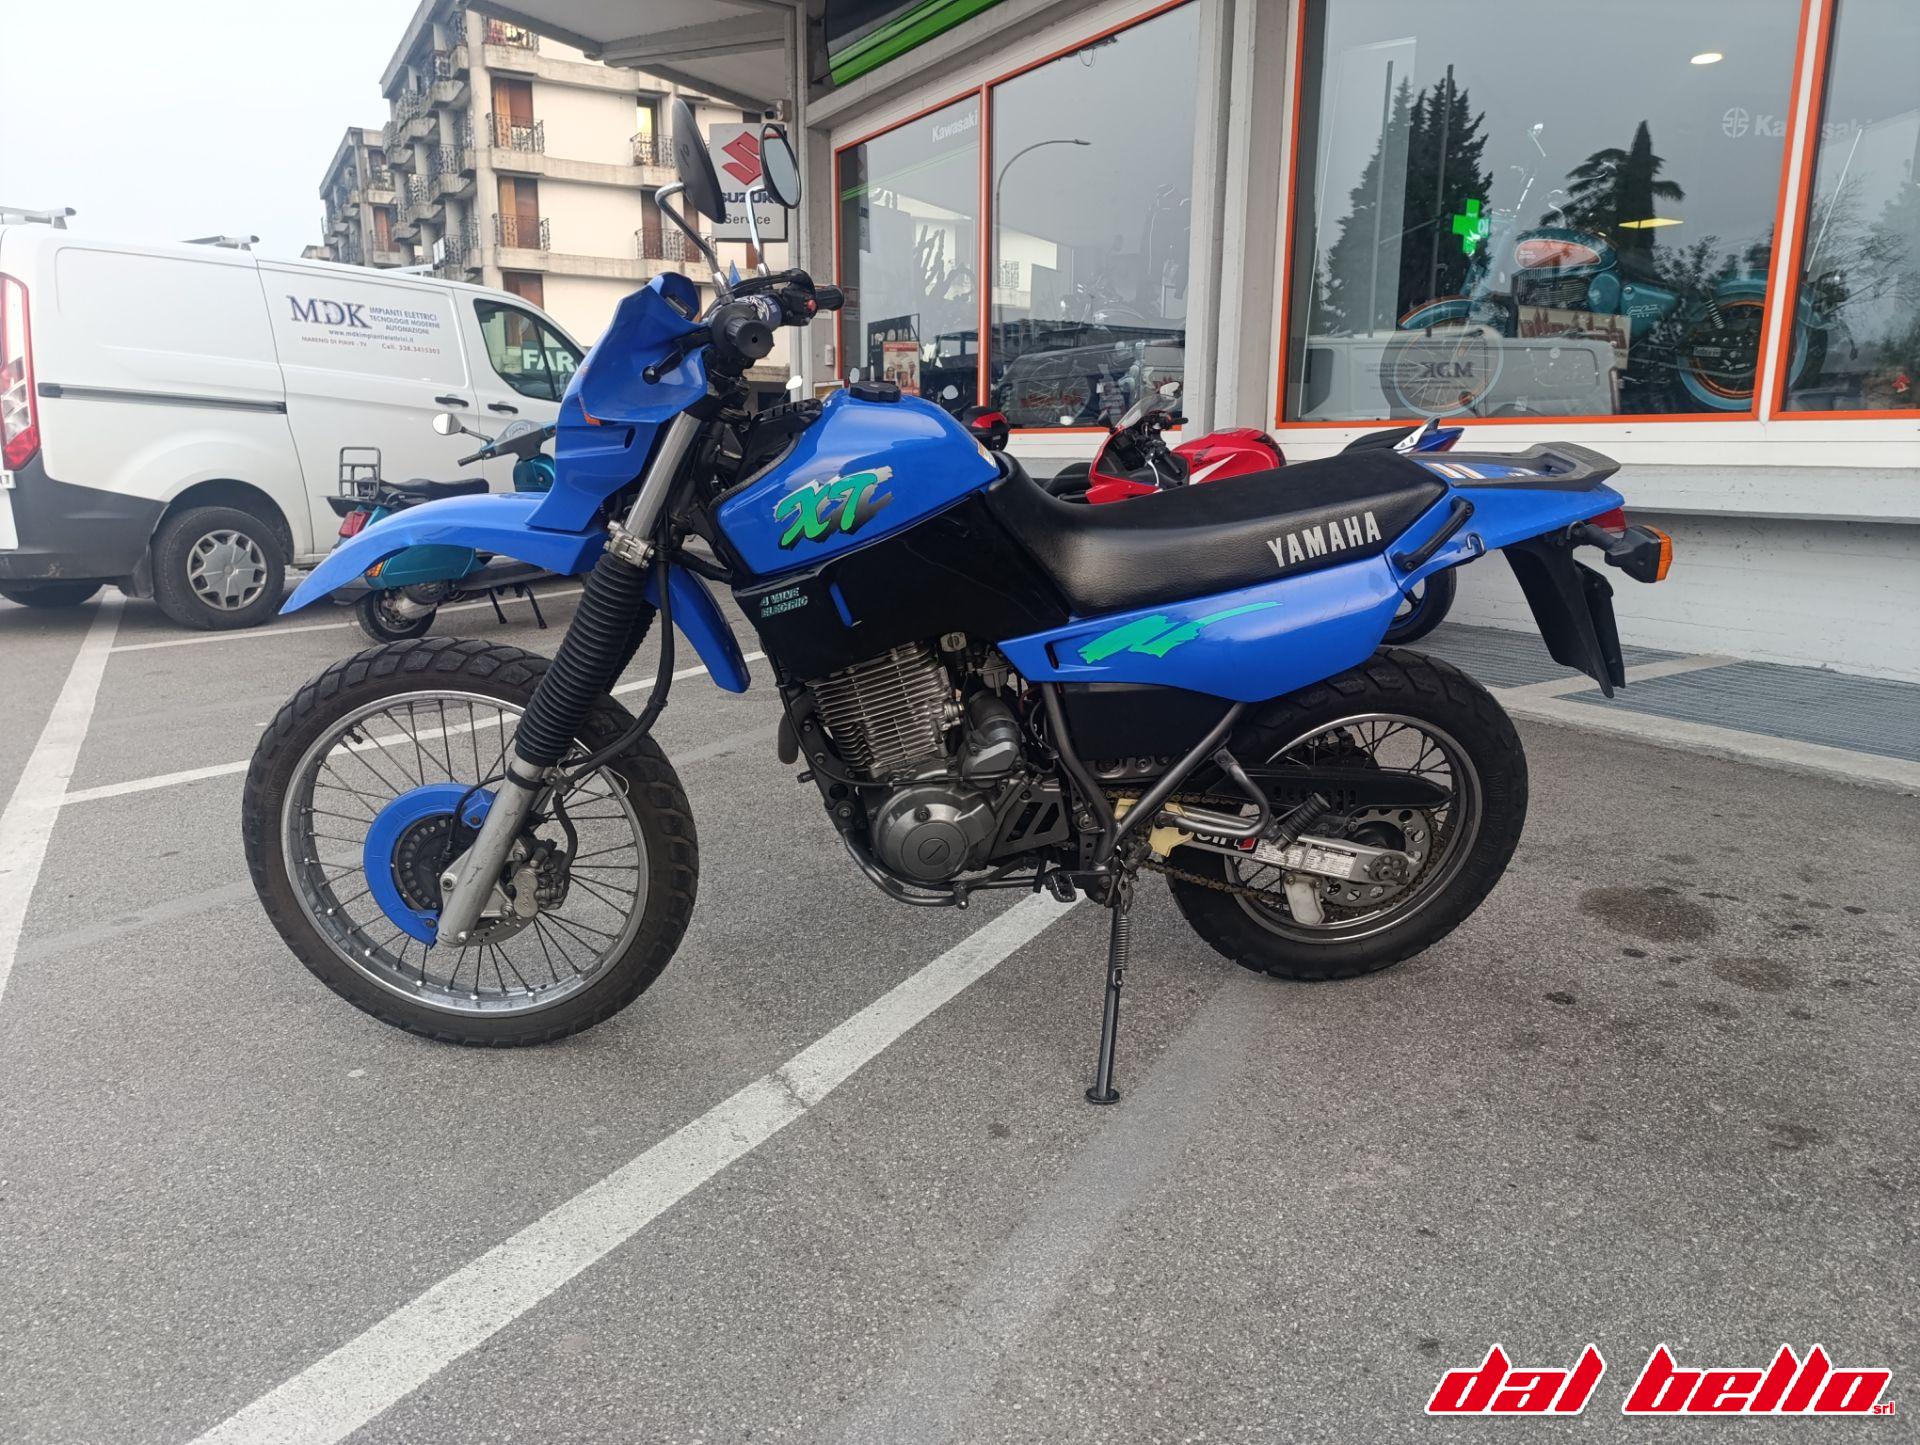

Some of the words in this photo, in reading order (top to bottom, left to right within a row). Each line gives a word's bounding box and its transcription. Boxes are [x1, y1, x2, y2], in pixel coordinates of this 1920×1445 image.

[932, 109, 978, 143] Kawasaki
[1754, 114, 1873, 139] Kasaki
[724, 213, 771, 225] Servce
[286, 295, 372, 329] MDK
[369, 306, 403, 317] IMPIANTI
[404, 310, 437, 321] ELETTRICI
[369, 315, 410, 326] TECNOLOGIE
[410, 319, 440, 329] MODERNE
[775, 468, 886, 549] XT
[1266, 511, 1382, 568] YAMAHA
[761, 595, 809, 618] ELECTRIC
